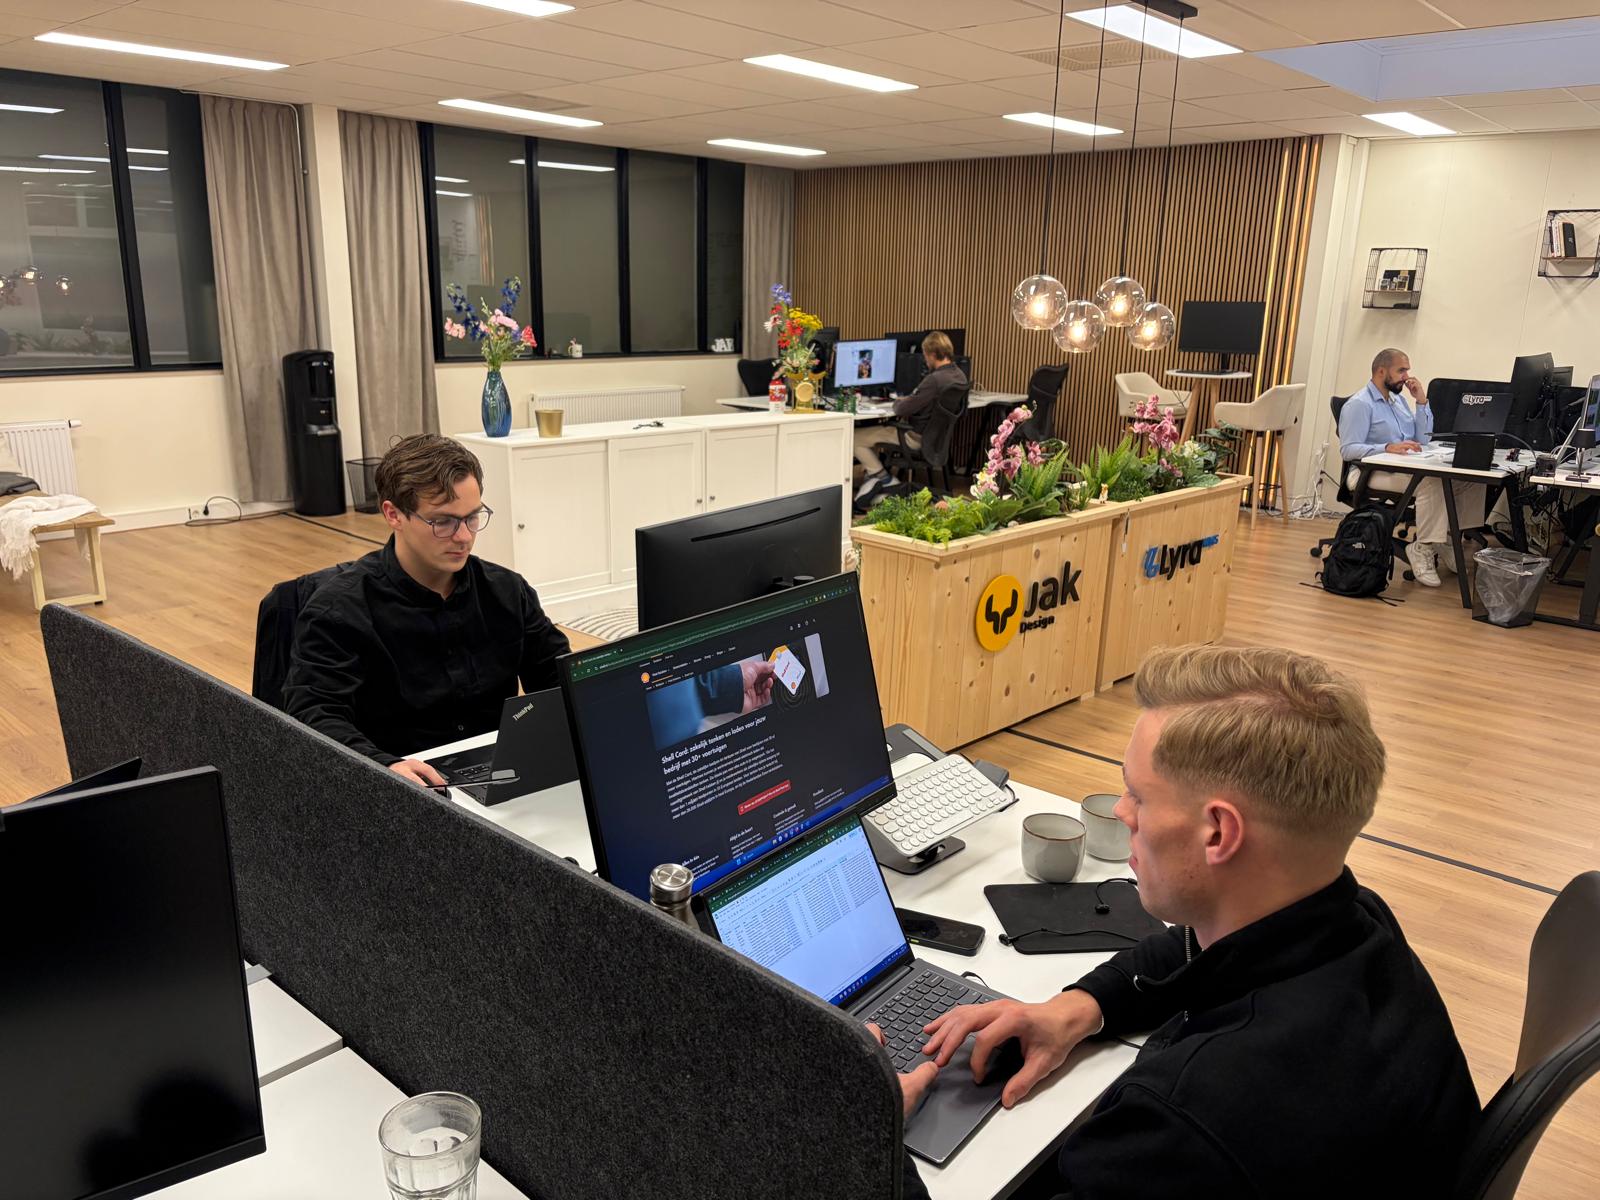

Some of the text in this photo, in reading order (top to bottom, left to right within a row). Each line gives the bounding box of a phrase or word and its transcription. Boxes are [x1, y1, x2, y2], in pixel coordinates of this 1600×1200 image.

[1469, 394, 1485, 405] Lyra
[1159, 539, 1203, 580] Lyra
[1019, 615, 1055, 634] Design
[661, 753, 674, 764] Shell
[689, 739, 707, 753] zakelijk
[707, 732, 724, 744] tanken
[730, 724, 744, 734] laden
[754, 715, 766, 725] jouw
[663, 761, 681, 775] bedrijf
[691, 753, 700, 762] 30+
[701, 742, 727, 758] voertuigen
